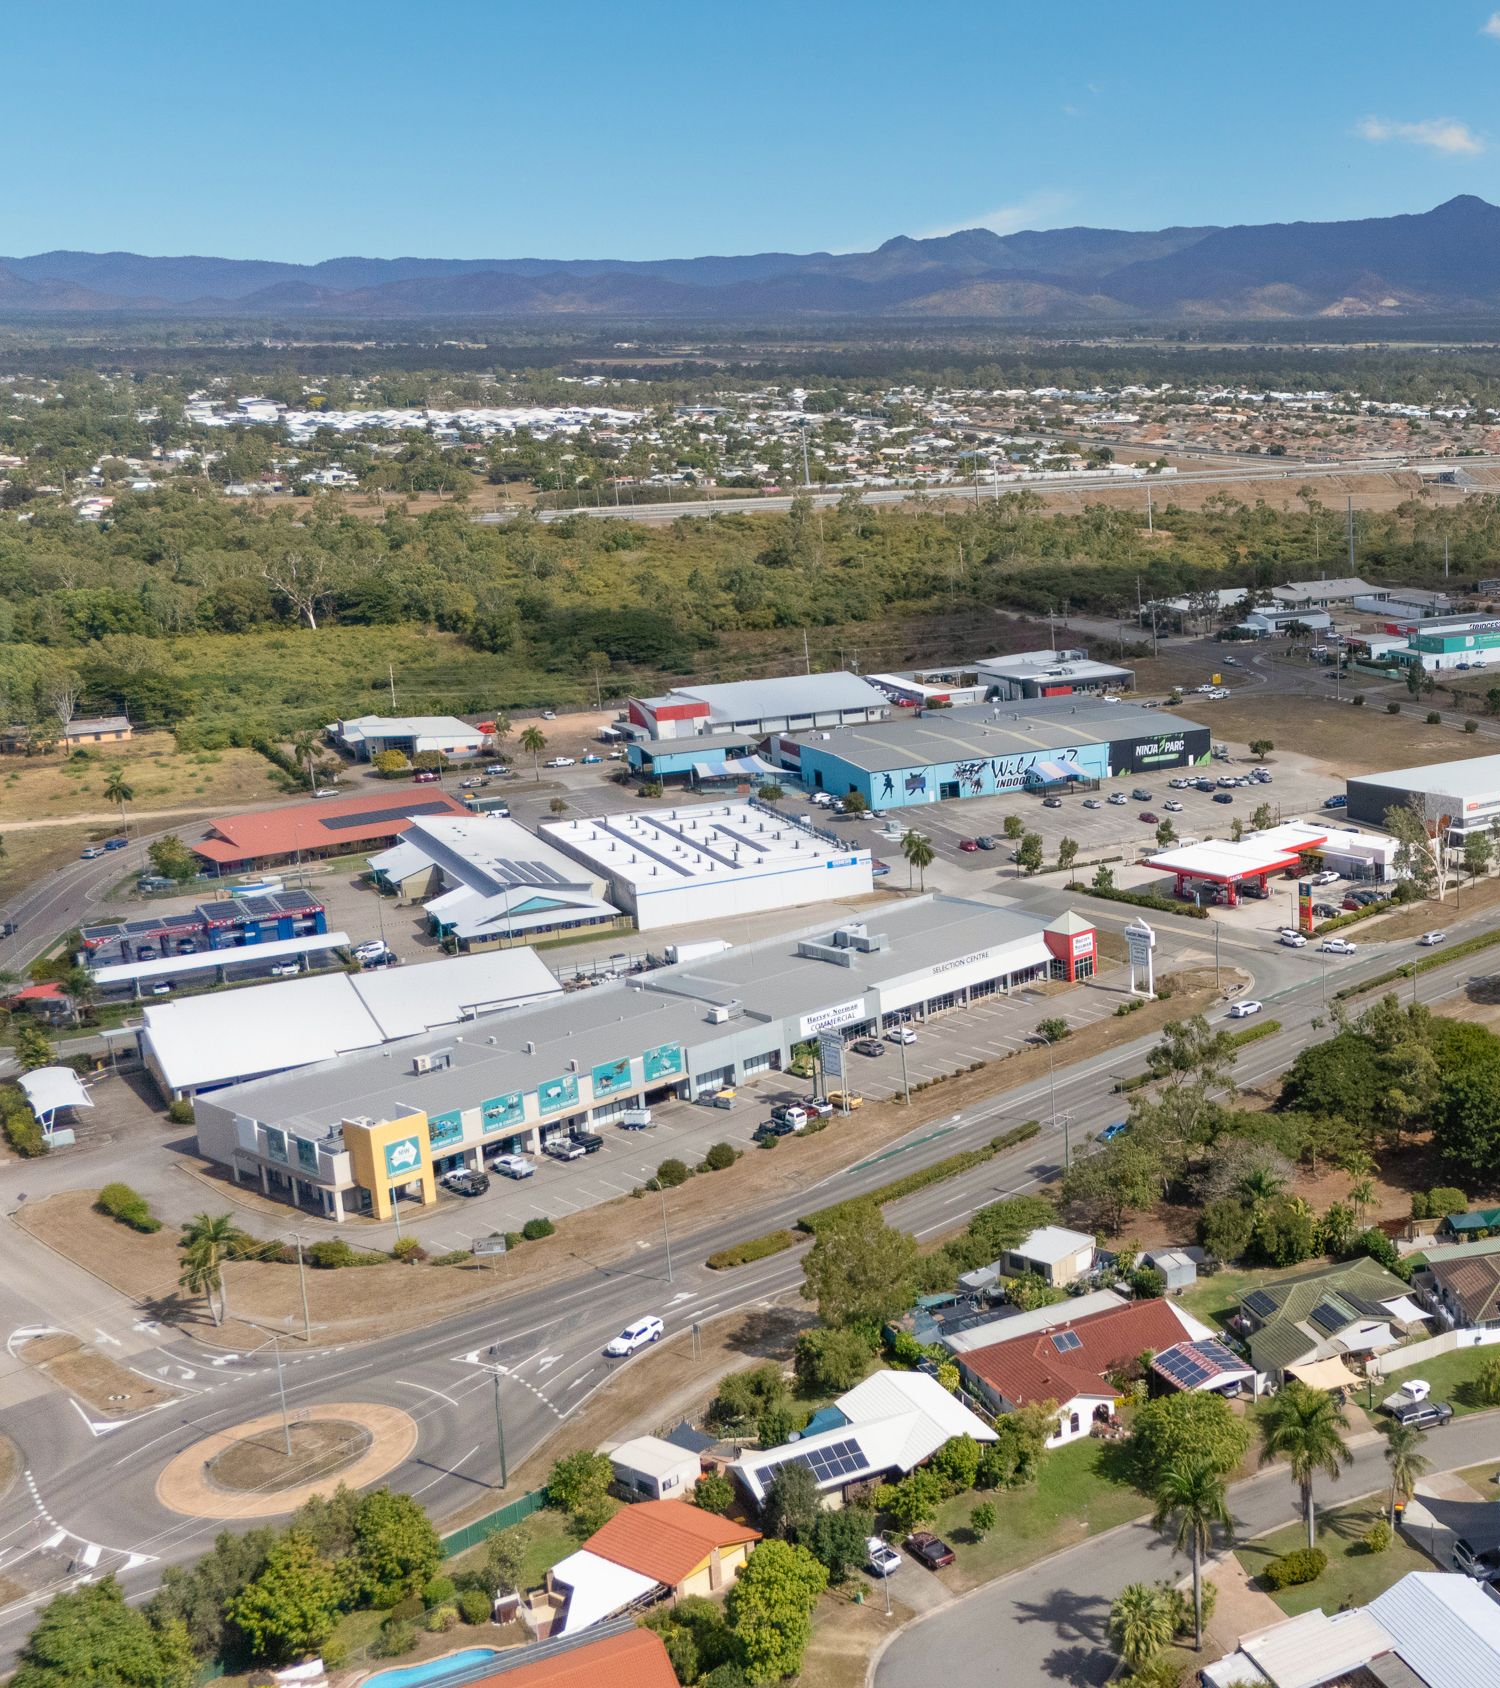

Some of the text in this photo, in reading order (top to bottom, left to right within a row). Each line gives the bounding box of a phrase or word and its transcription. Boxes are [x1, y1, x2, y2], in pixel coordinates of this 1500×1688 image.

[1135, 740, 1185, 756] NINJA PARC
[991, 755, 1037, 779] Wild
[996, 775, 1032, 788] INDOOR
[932, 951, 990, 975] SELECTION CENTRE
[807, 1003, 858, 1024] Harvey Norman
[810, 1012, 856, 1031] COMMERCIAL
